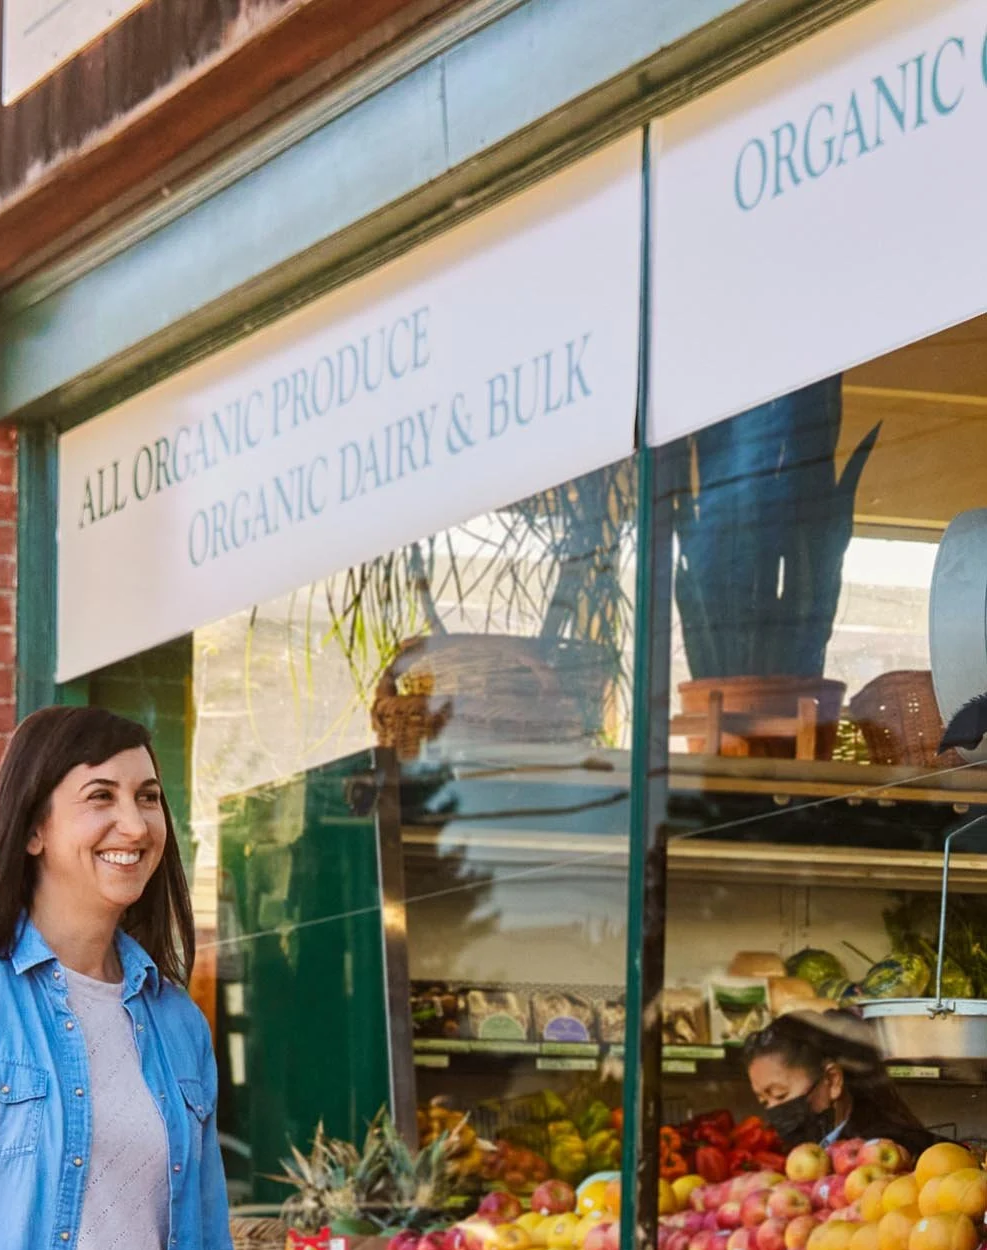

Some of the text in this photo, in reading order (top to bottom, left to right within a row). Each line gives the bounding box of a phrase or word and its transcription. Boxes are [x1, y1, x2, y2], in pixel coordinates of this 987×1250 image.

[733, 36, 965, 212] ORGANIC
[78, 306, 431, 529] ALL ORGANIC PRODUCE
[187, 332, 594, 568] ORGANIC DAIRY & BULK
